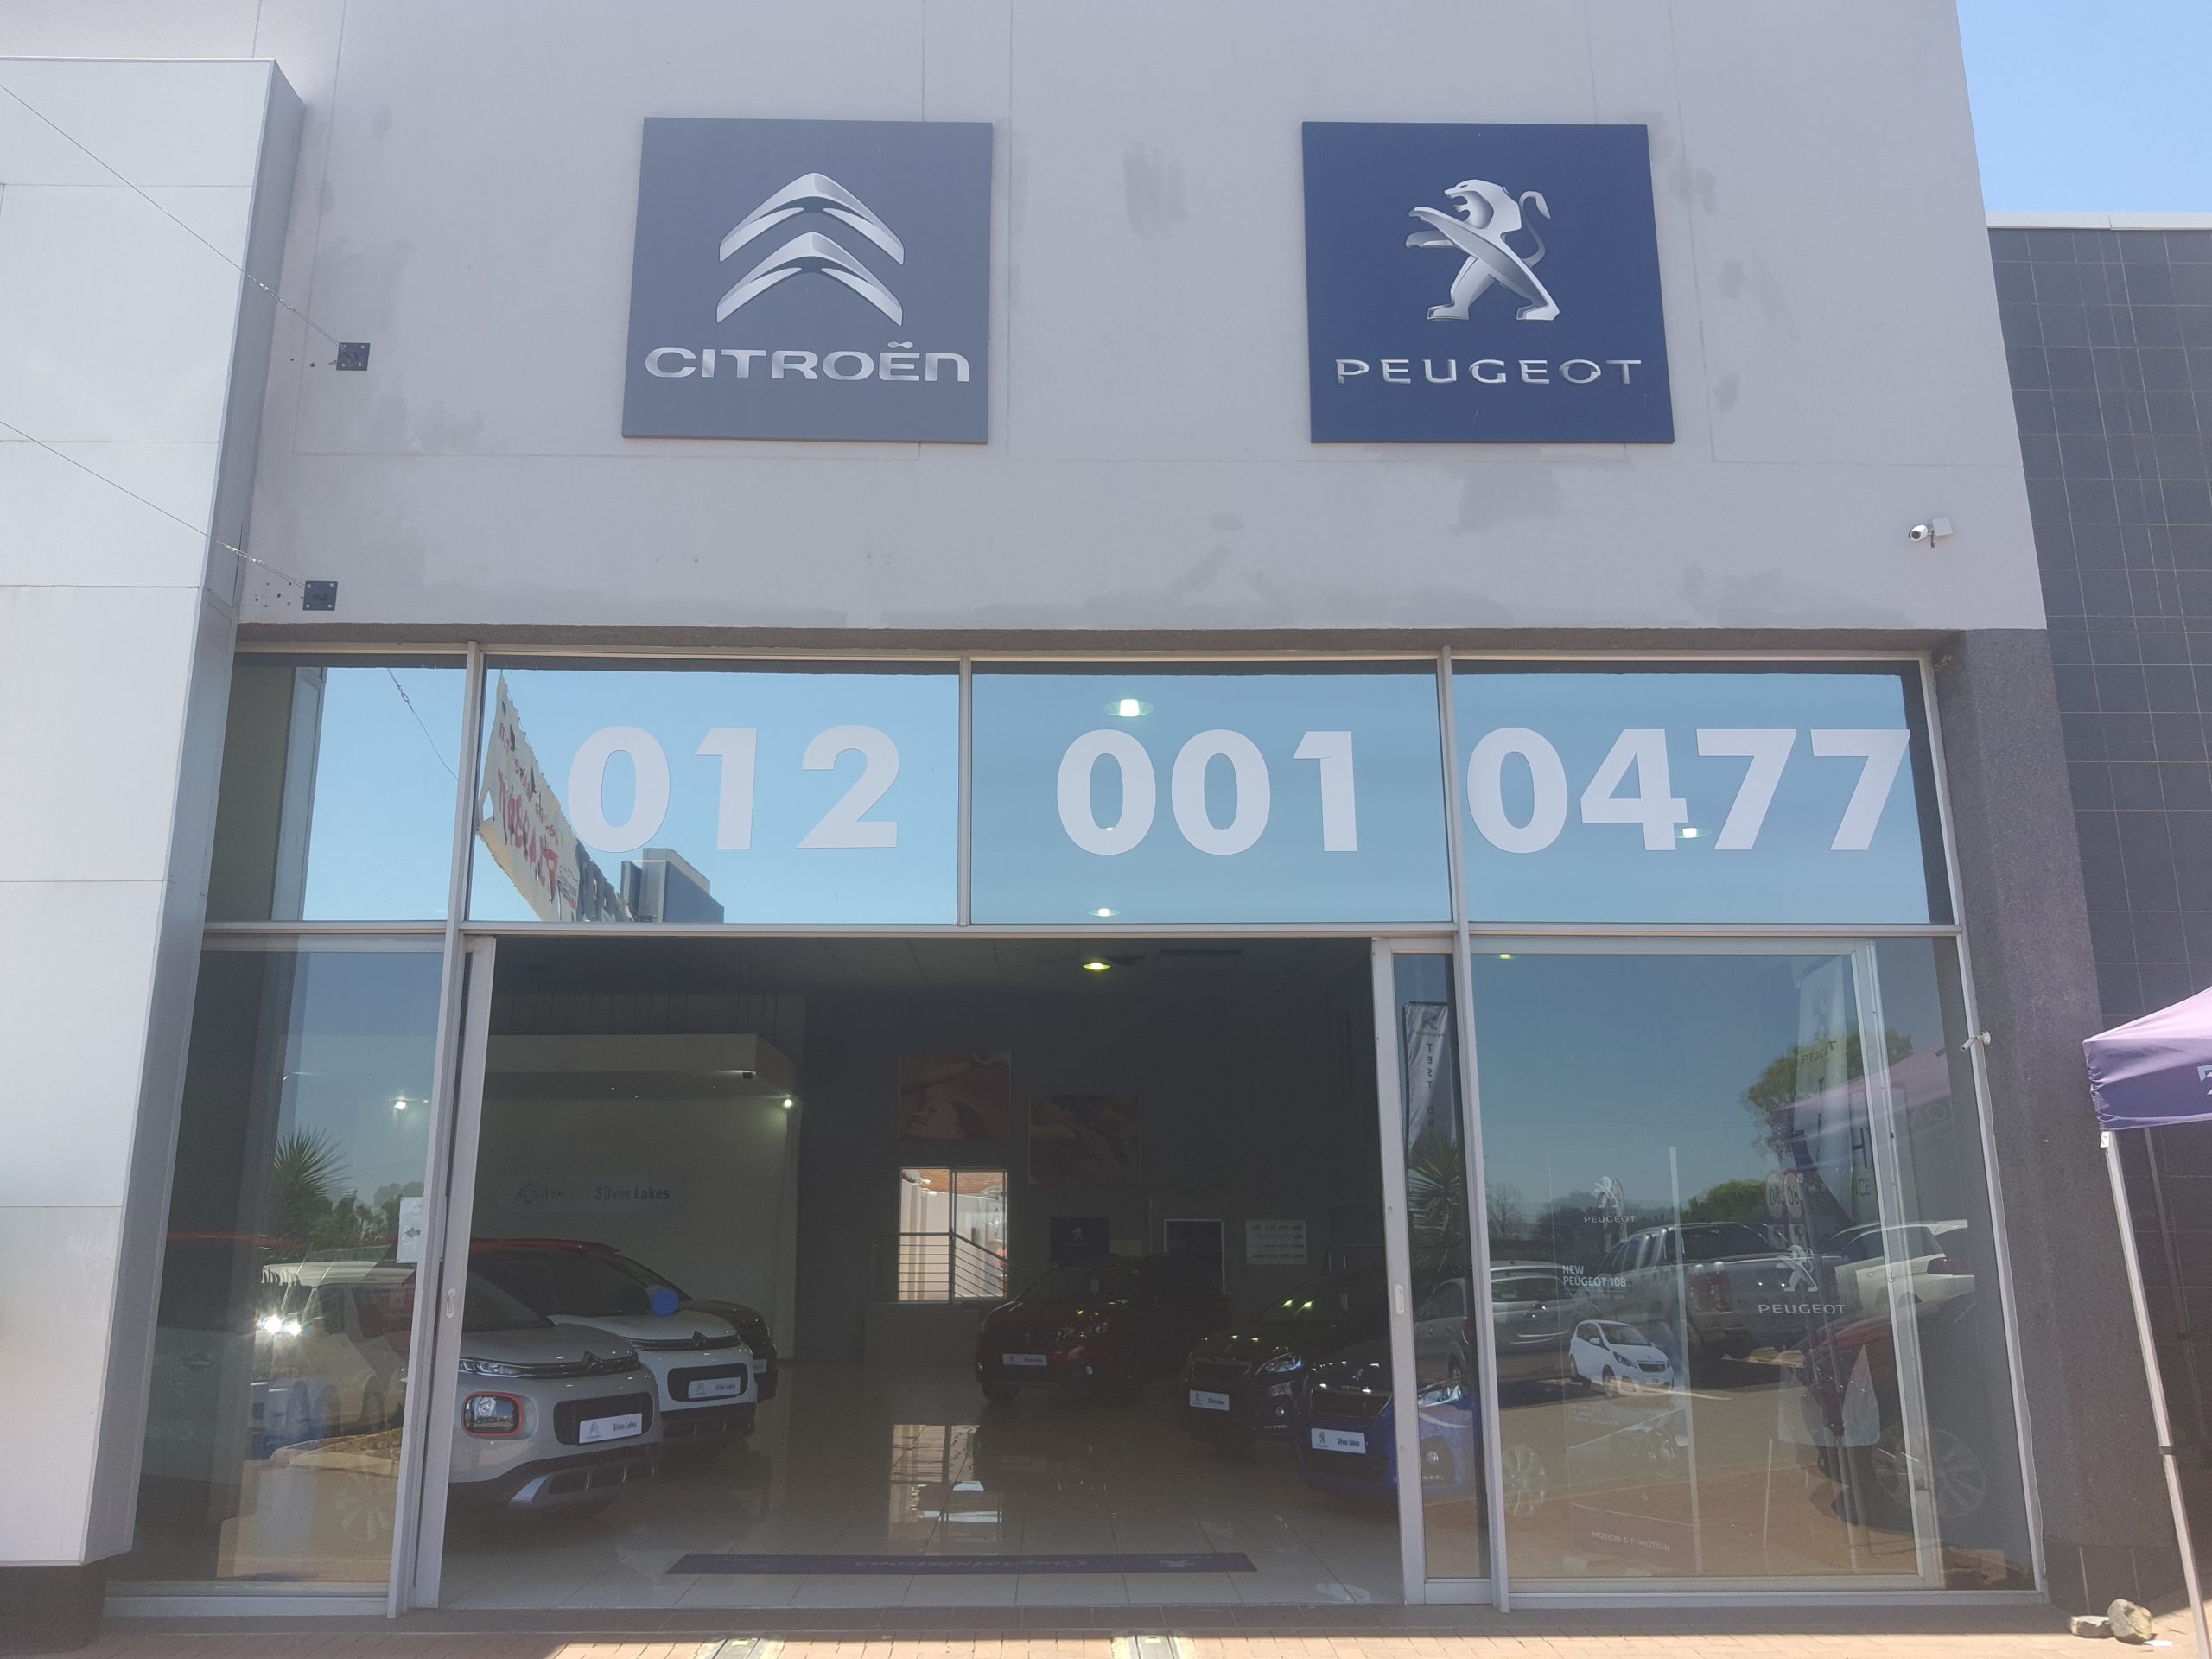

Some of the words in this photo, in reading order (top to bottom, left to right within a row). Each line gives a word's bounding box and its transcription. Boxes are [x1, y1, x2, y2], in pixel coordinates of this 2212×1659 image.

[1335, 359, 1642, 385] PEUGEOT
[568, 724, 899, 852] 012
[1057, 729, 1357, 855] 001
[1467, 727, 1911, 854] 0477
[594, 1185, 632, 1200] Silver
[634, 1186, 671, 1200] Lakes
[1584, 1215, 1637, 1224] PEUGEOT
[1562, 1264, 1585, 1274] NEW
[1562, 1276, 1608, 1287] PEUGEOT
[1758, 1303, 1846, 1314] PEUGEOT
